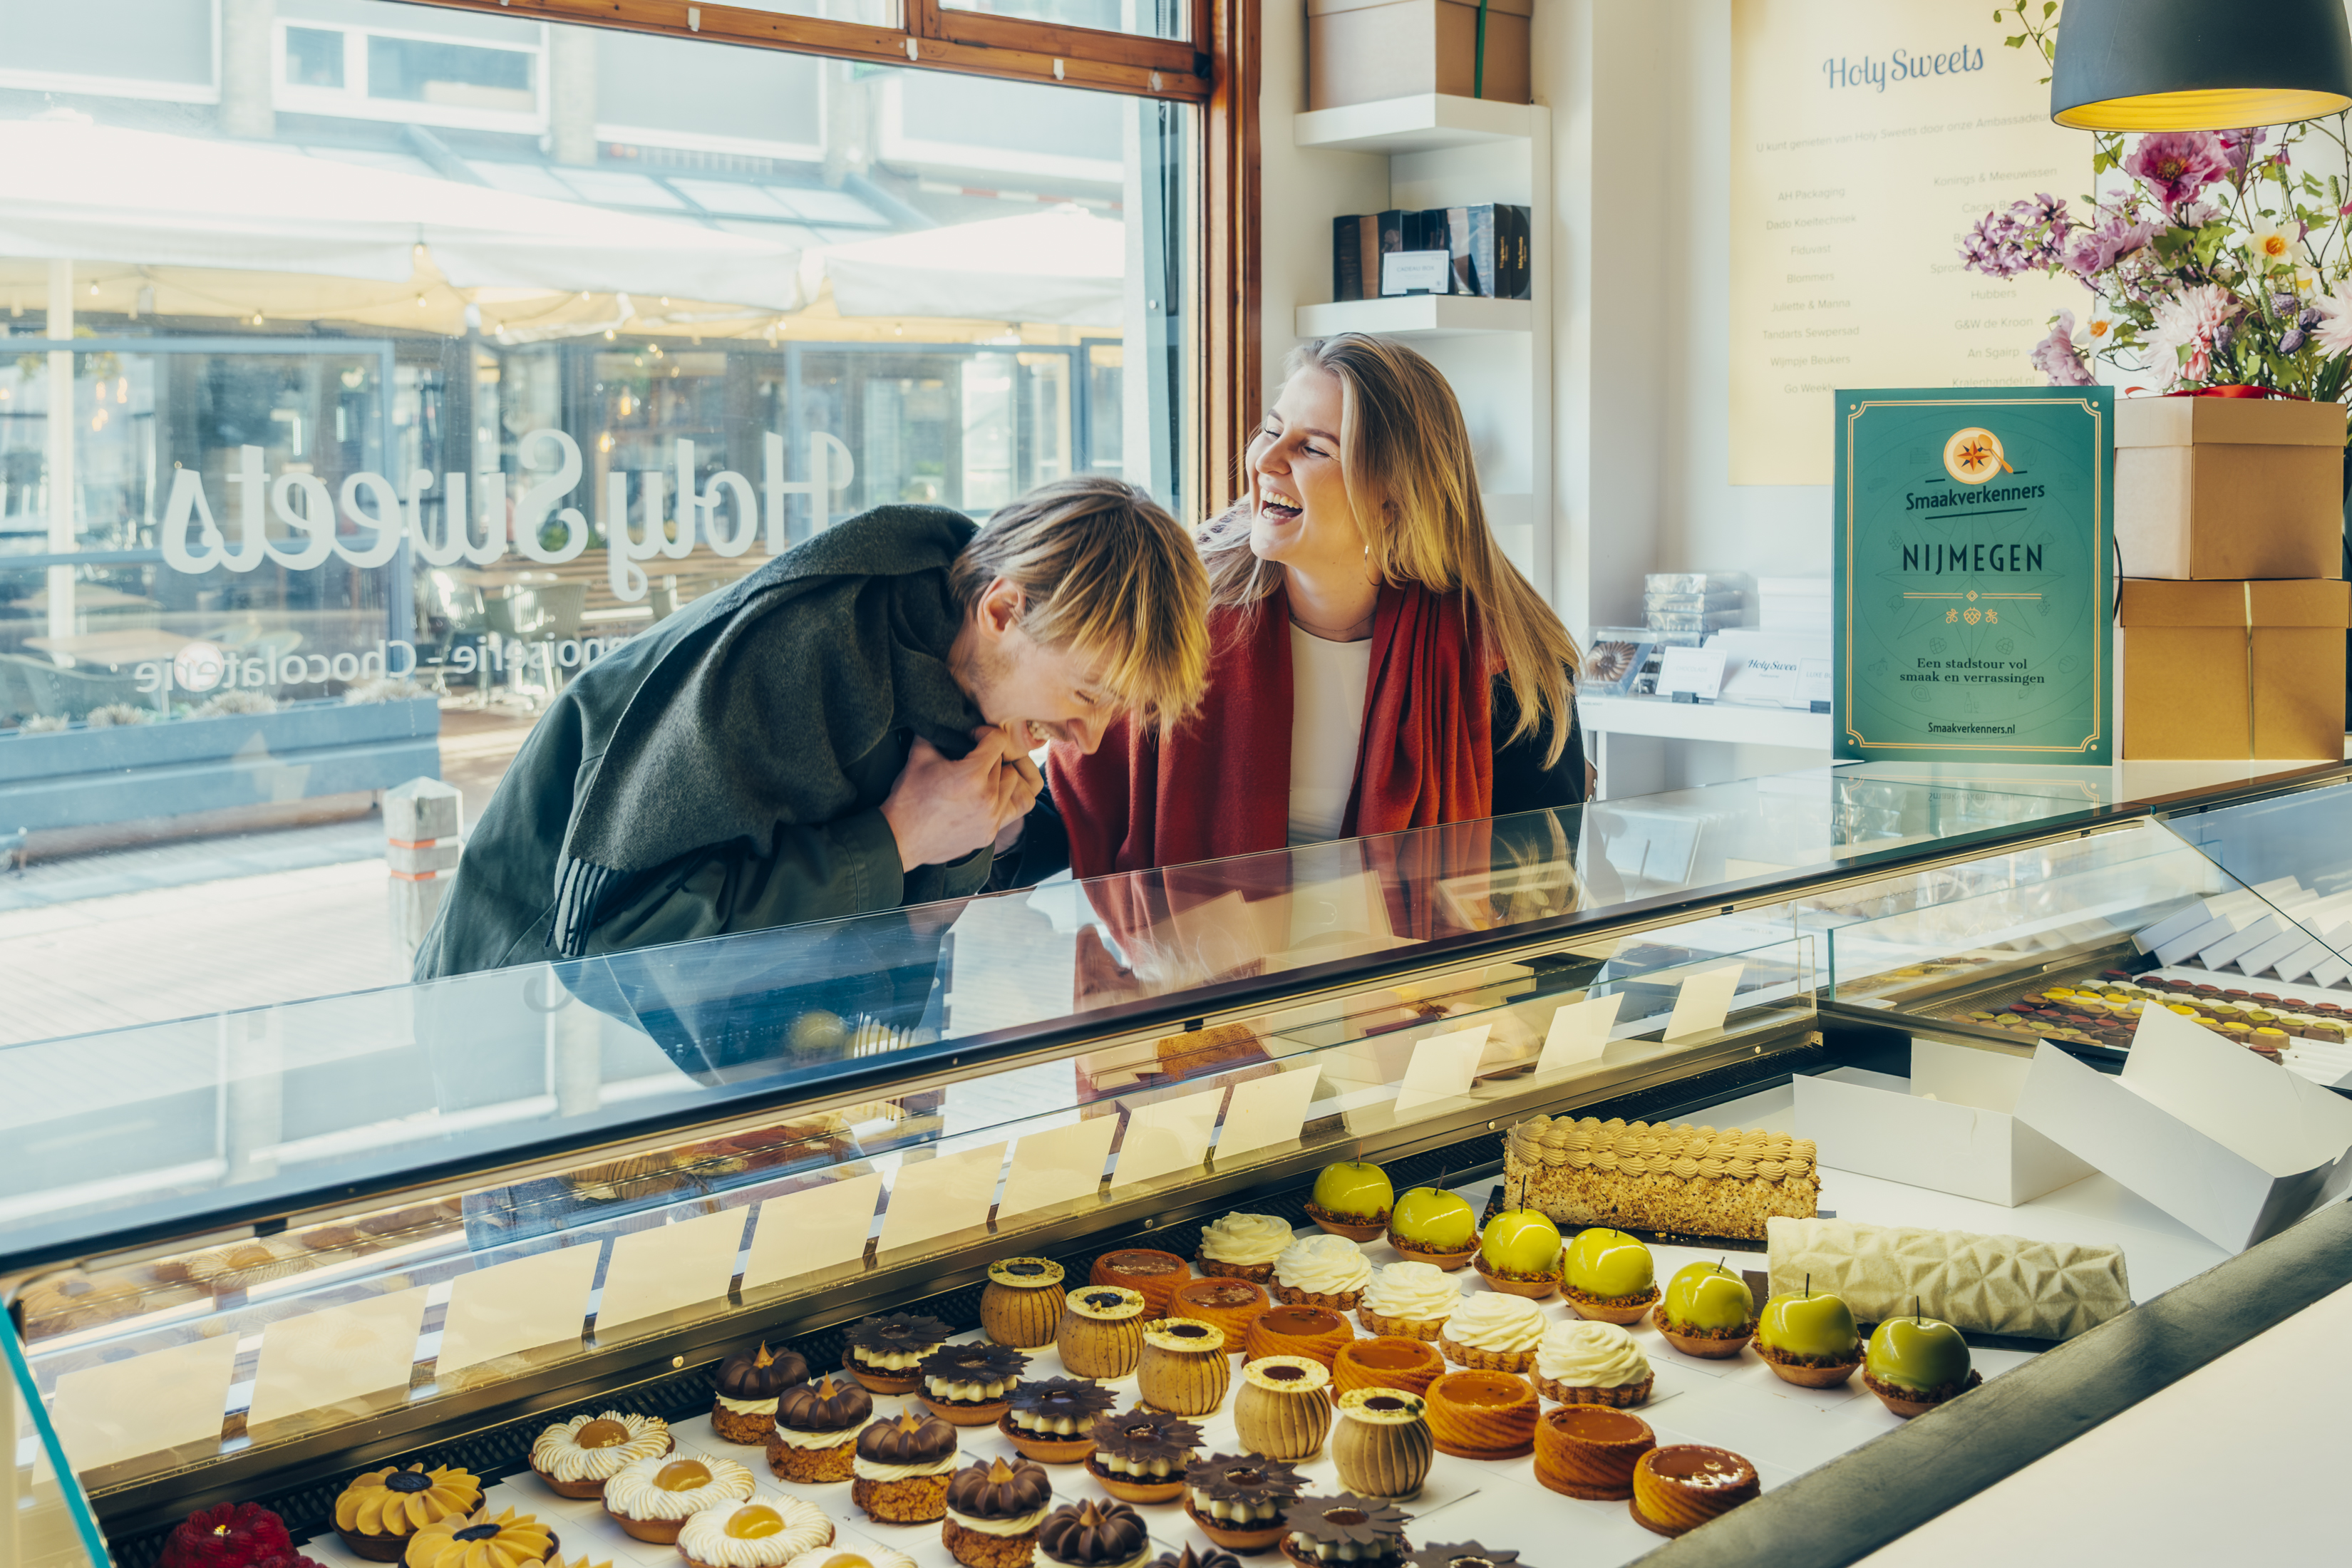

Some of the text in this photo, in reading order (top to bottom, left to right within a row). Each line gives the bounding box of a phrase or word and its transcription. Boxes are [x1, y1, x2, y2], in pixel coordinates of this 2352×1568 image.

[1756, 143, 1764, 153] U
[1766, 141, 1787, 151] kunt
[1789, 136, 1832, 152] genieten
[1855, 130, 1878, 144] Holy
[1880, 127, 1917, 140] Sweets
[1920, 124, 1944, 135] door
[1946, 122, 1973, 133] onze
[1934, 168, 2058, 188] Konings & Meeuwissen
[1778, 187, 1845, 202] AH Packaging
[1961, 202, 1995, 215] Cacao
[1766, 215, 1856, 231] Dado Koeltechniek
[1790, 244, 1830, 255] Fiduvast
[1787, 274, 1834, 284] Blommers
[1971, 289, 2016, 299] Hubbers
[1771, 299, 1850, 312] Juliette & Manna
[1955, 318, 2033, 329] G&W de Kroon
[1763, 326, 1860, 340] Tandarts Sewpersad
[1967, 349, 1981, 358] An
[1811, 356, 1850, 365] Beukers
[1784, 383, 1836, 394] Go Weekly
[1905, 484, 2046, 511] Smaakverkenners
[1903, 544, 2042, 575] NIJMEGEN
[1917, 658, 2028, 670] Een stadstour vol
[1899, 671, 2045, 686] smaak en verrassingen
[1928, 722, 2016, 734] Smaakverkenners.nl
